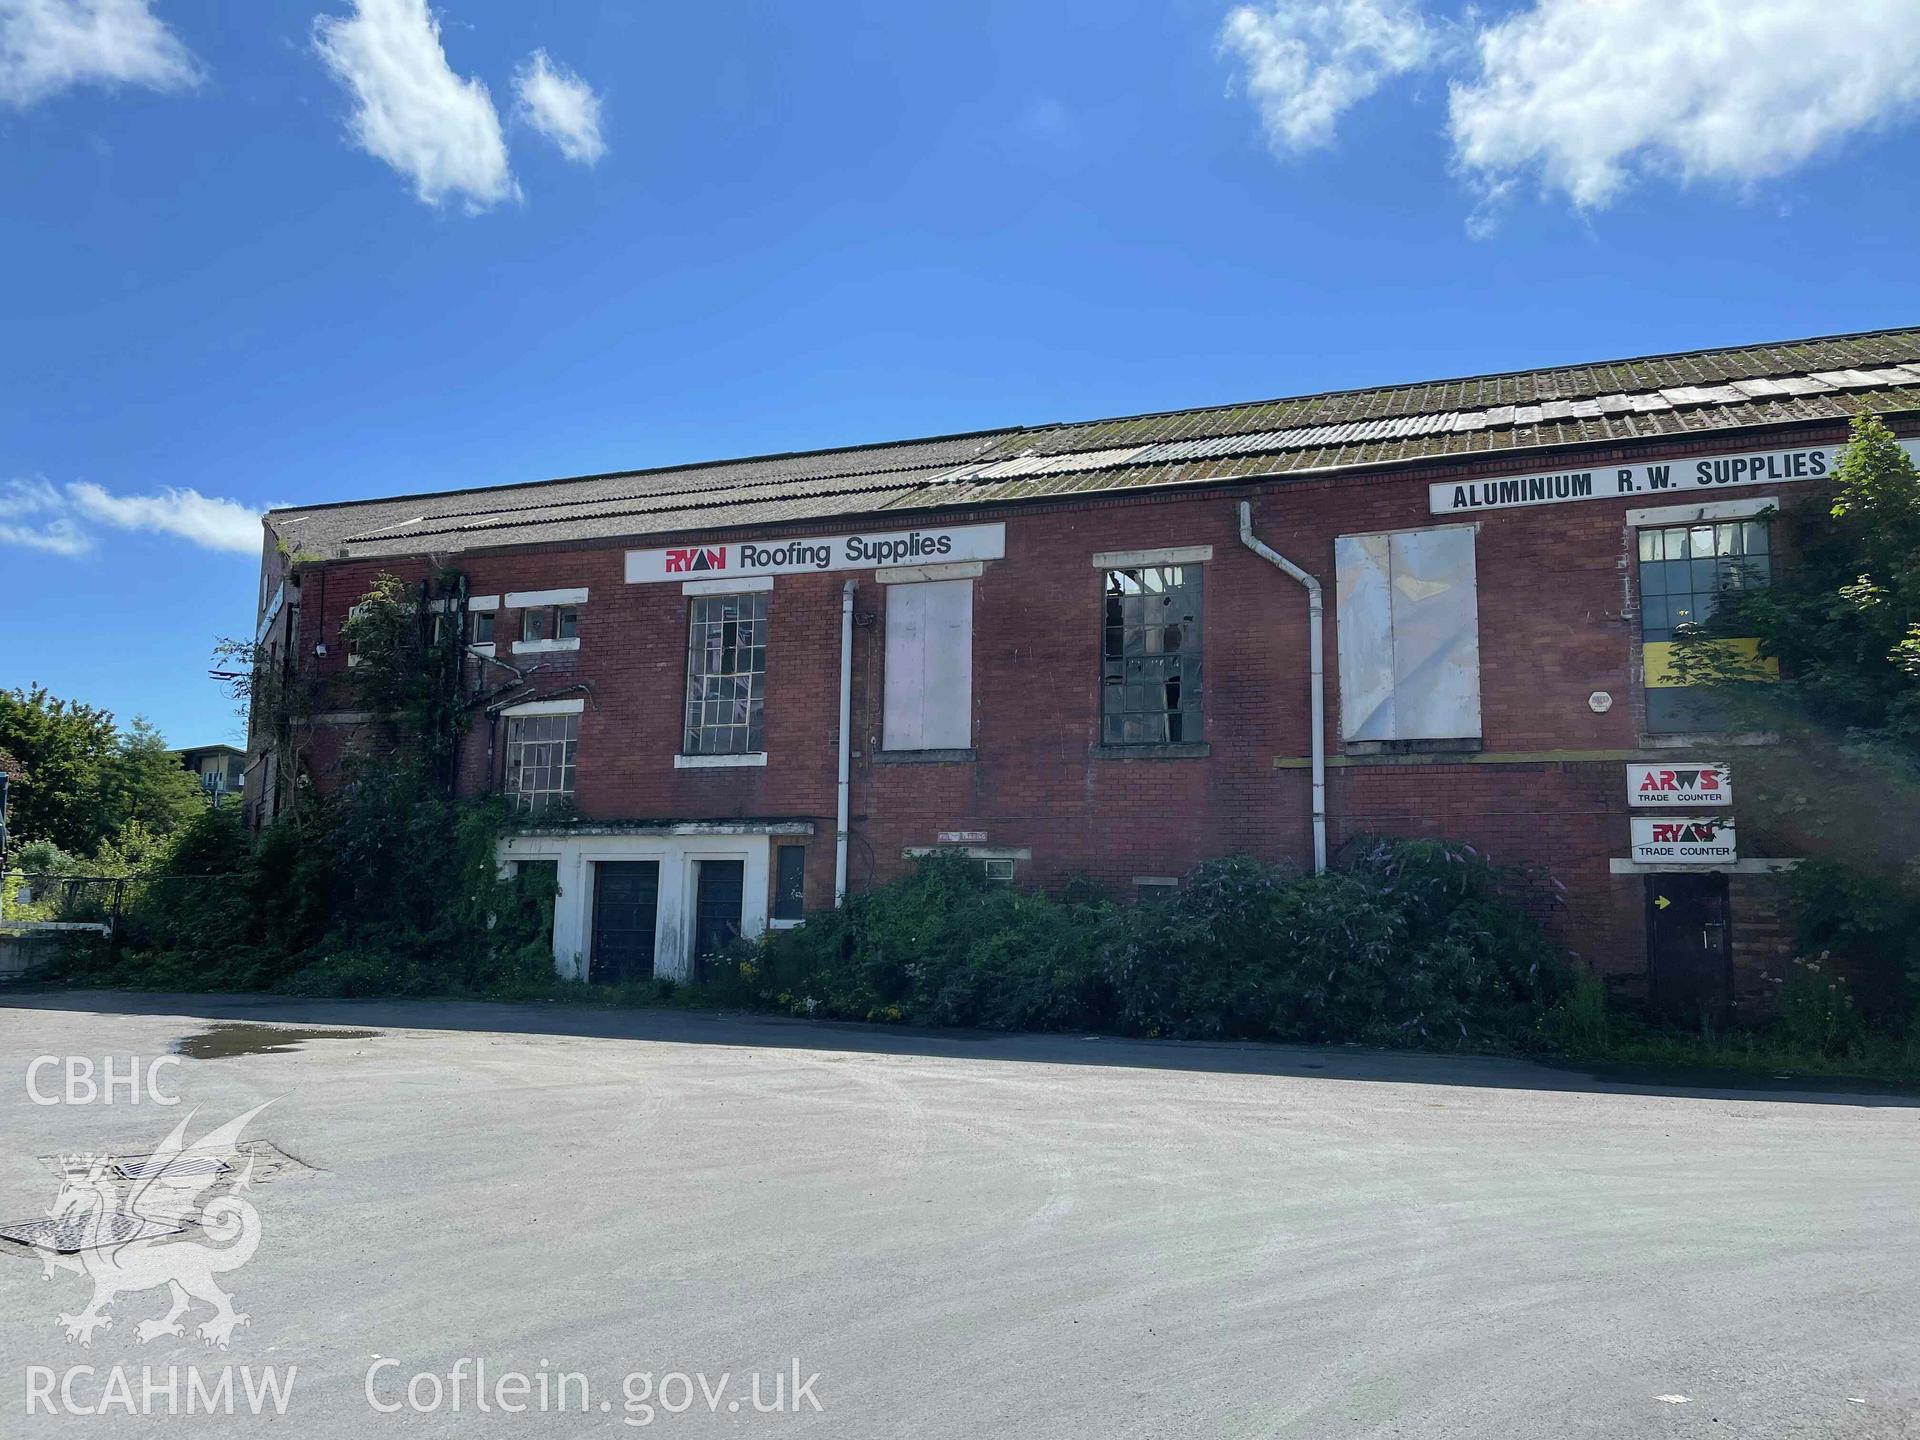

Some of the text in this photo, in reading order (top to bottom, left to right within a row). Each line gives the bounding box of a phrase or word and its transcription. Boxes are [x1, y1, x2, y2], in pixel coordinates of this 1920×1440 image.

[1453, 473, 1592, 508] ALUMINIUM
[1697, 451, 1827, 485] SUPPLIES
[665, 533, 952, 573] RYAN Roofing Supplies
[1640, 770, 1719, 791] ARWS
[1638, 793, 1722, 802] TRADE COUNTER
[1652, 824, 1714, 842] RYAN
[1639, 847, 1730, 856] TRADE COUNTER
